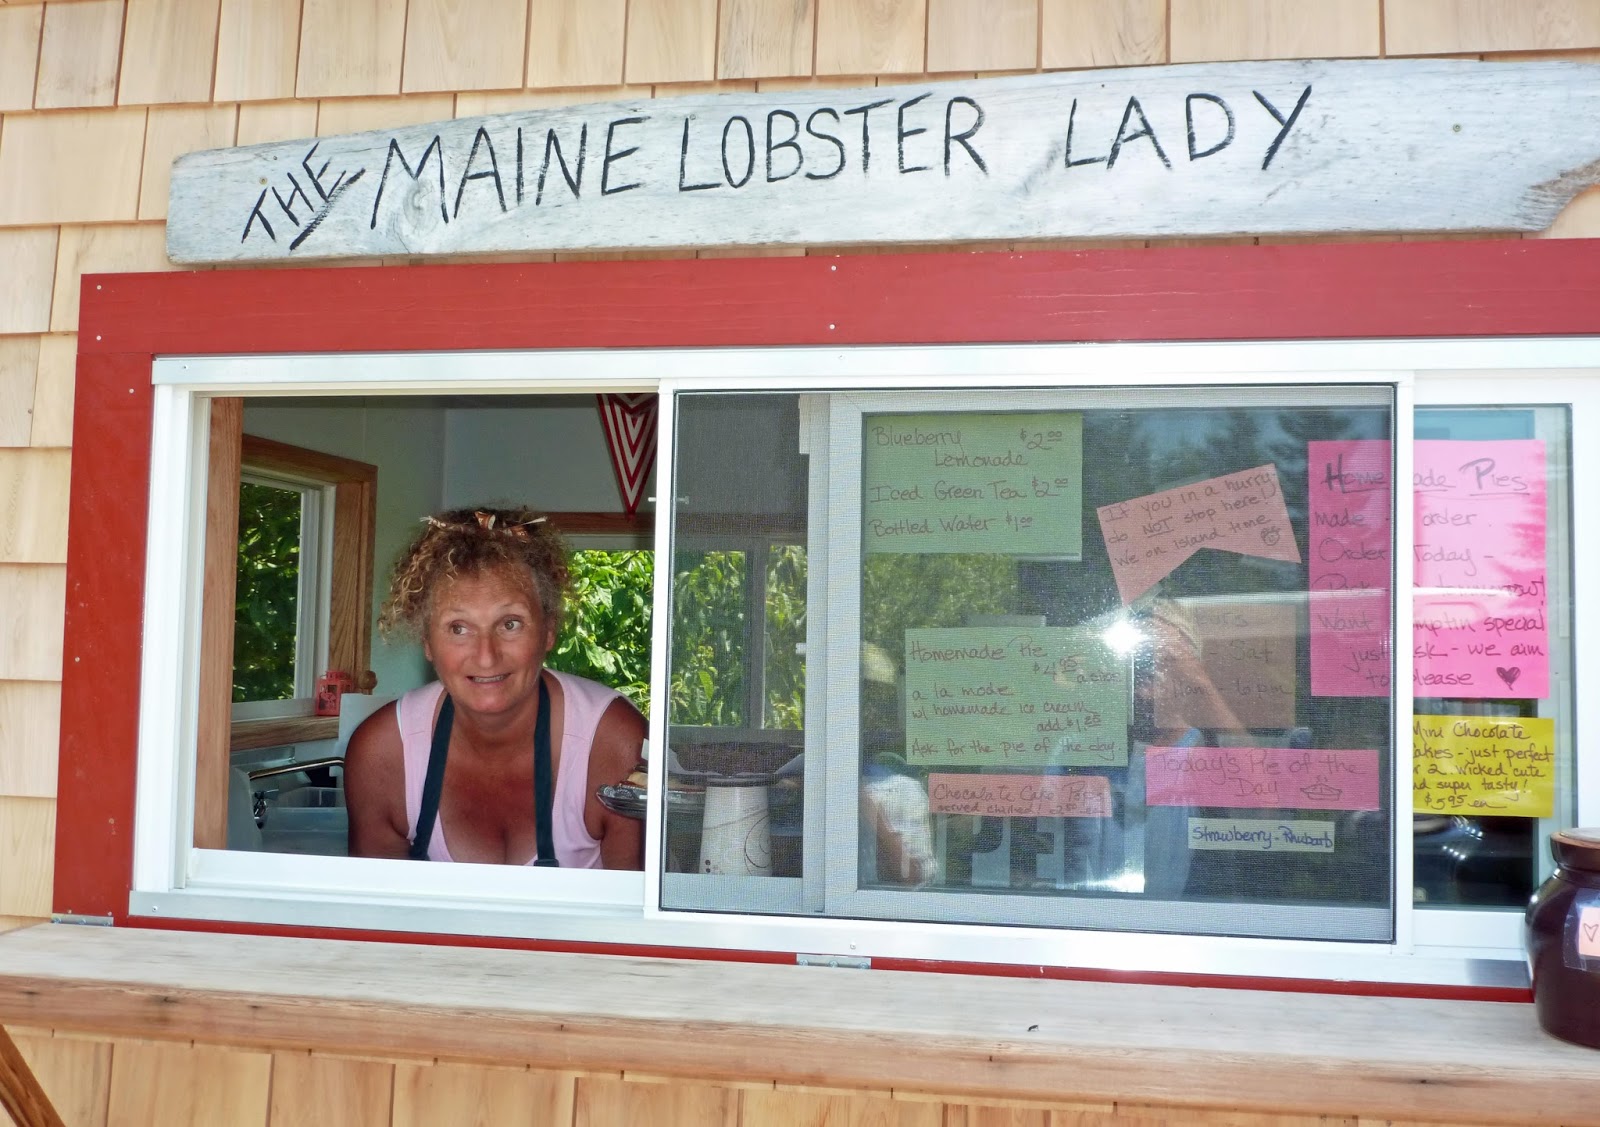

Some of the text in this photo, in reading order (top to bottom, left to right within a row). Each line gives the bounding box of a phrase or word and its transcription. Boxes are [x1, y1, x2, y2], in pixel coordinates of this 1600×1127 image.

[241, 86, 1311, 244] THE MAINE LOBSTER LADY
[872, 426, 963, 451] Blueberry
[935, 450, 1028, 467] Lemonade
[1460, 457, 1529, 492] Pies
[870, 485, 924, 502] Iced
[934, 481, 984, 500] Green
[988, 481, 1027, 498] Tea
[1205, 486, 1219, 496] a
[869, 518, 933, 537] Bottled
[939, 514, 996, 532] Water
[1108, 532, 1128, 543] do
[1143, 516, 1174, 538] NOT
[1184, 508, 1216, 524] stop
[1115, 515, 1271, 566] We on island time
[1319, 537, 1387, 563] Order
[1317, 608, 1372, 630] Want
[1483, 608, 1544, 637] special
[910, 635, 1048, 661] Homemade Pie
[1413, 641, 1448, 659] sk
[1467, 643, 1501, 656] we
[1510, 643, 1544, 656] aim
[1366, 668, 1390, 688] to
[912, 682, 1014, 700] a la mode
[933, 702, 1013, 716] homemade
[1043, 701, 1097, 714] cream
[1036, 718, 1065, 733] add
[1453, 722, 1530, 740] Chocolate
[911, 741, 938, 756] Ask
[947, 740, 966, 757] for
[969, 741, 992, 754] the
[1000, 741, 1026, 758] pie
[1033, 741, 1051, 754] of
[1465, 744, 1500, 765] just
[1503, 742, 1554, 767] perfect
[1153, 750, 1241, 786] Today's
[1289, 753, 1312, 774] of
[1319, 755, 1366, 775] the
[1513, 764, 1547, 778] cute
[1229, 777, 1280, 804] Day
[1436, 782, 1472, 795] super
